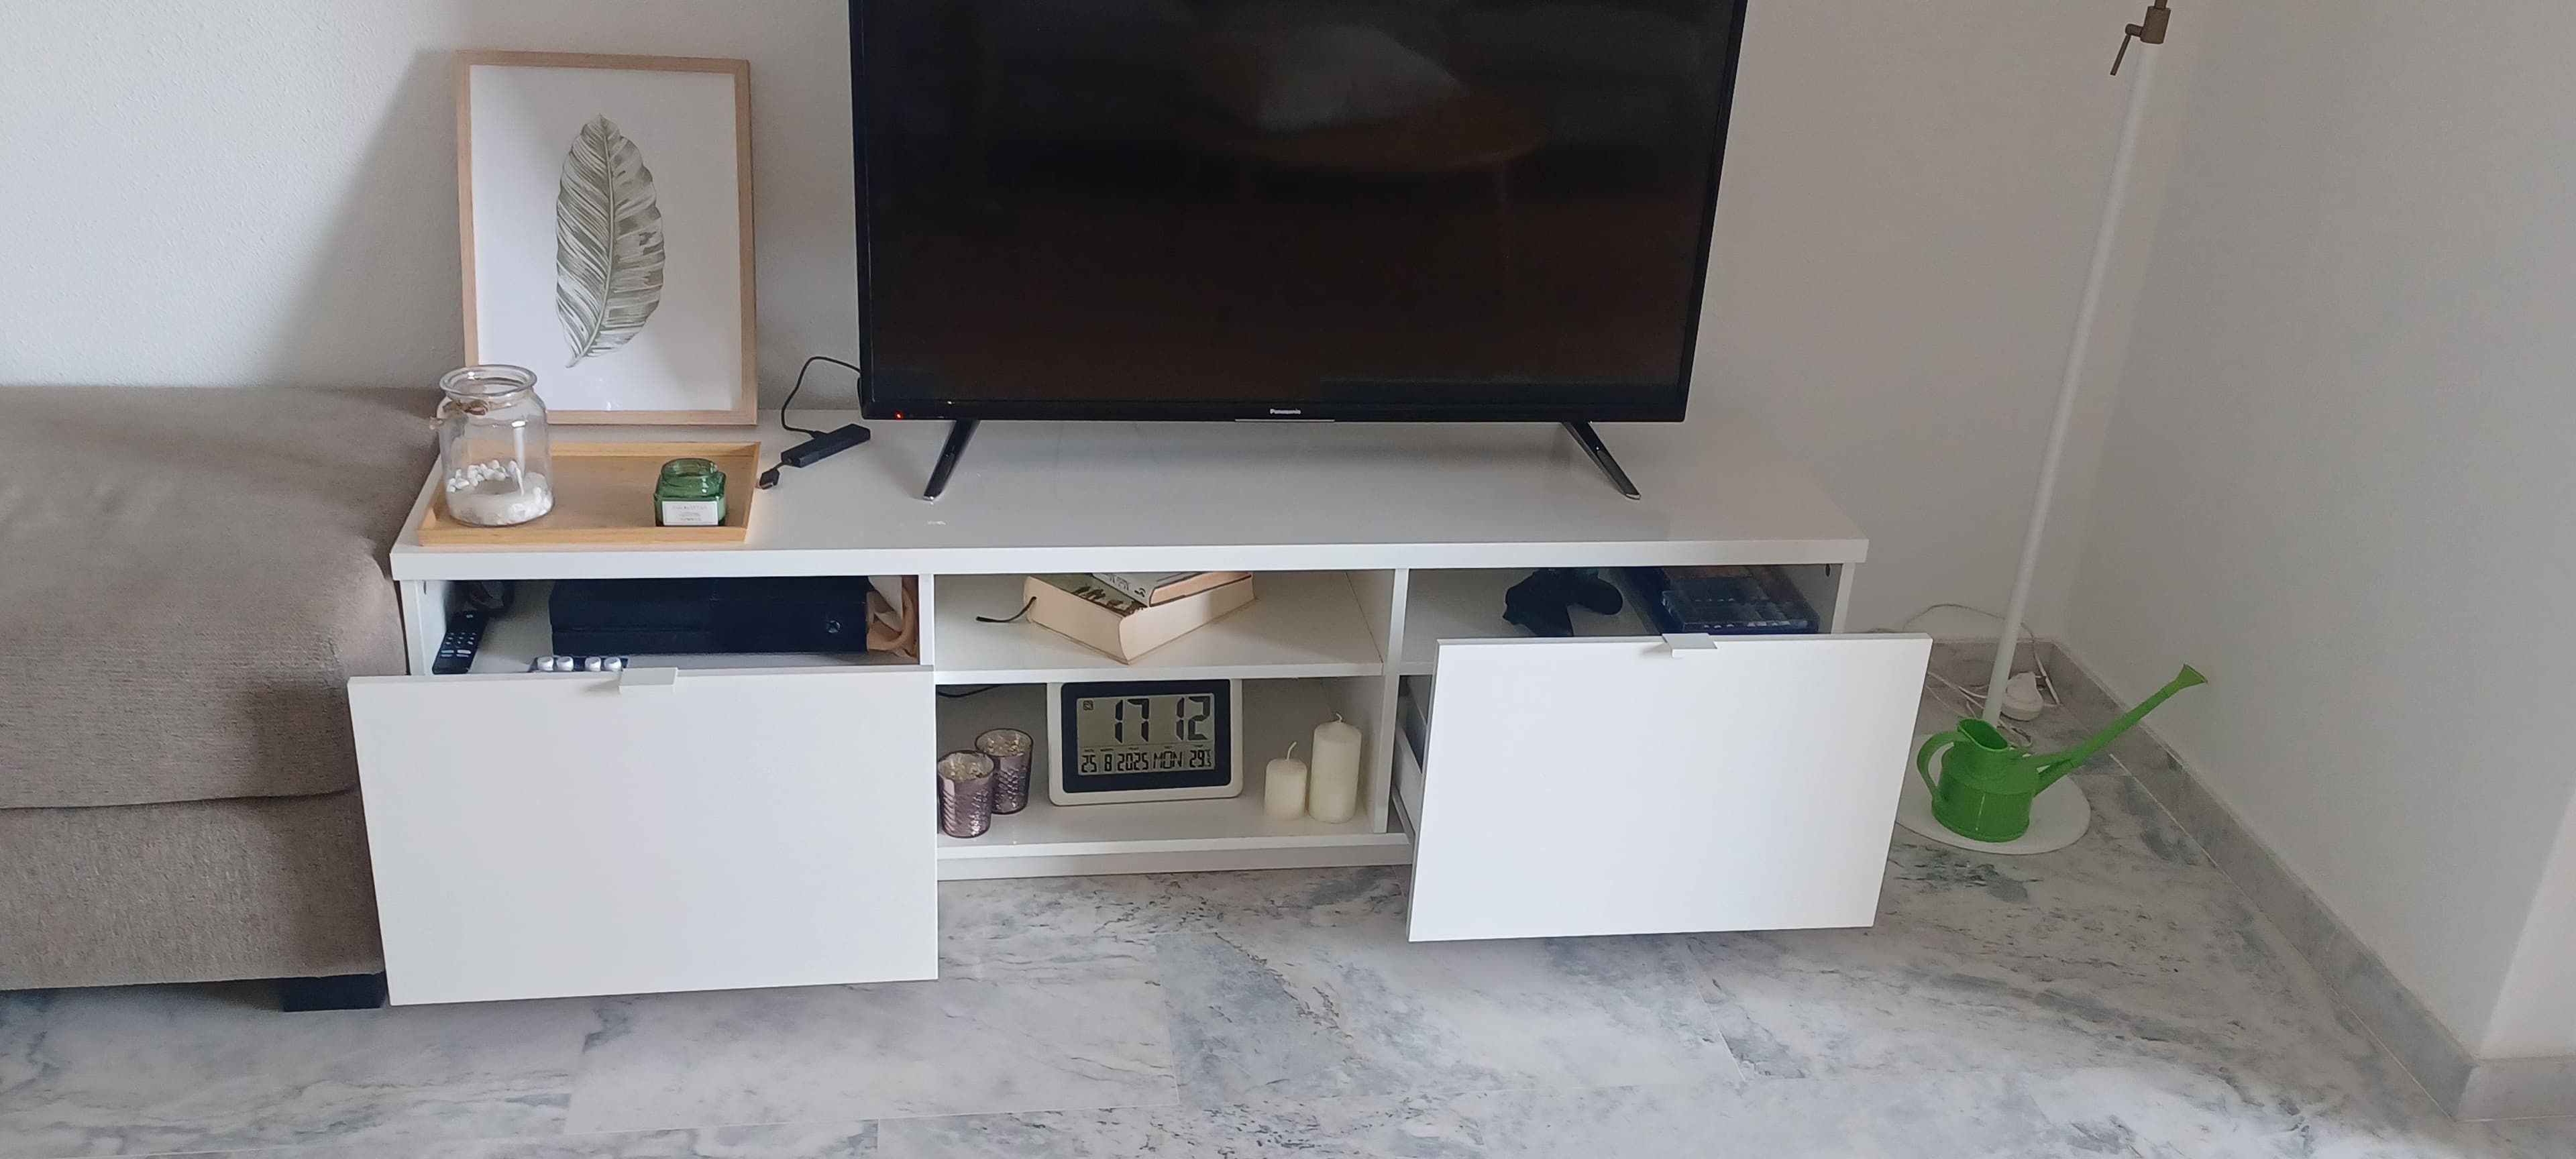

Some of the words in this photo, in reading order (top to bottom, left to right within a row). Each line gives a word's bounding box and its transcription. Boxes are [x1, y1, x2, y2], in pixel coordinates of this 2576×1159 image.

[1081, 755, 1097, 773] 25
[1104, 754, 1112, 771] 8
[1117, 752, 1149, 771] 2025
[1153, 751, 1182, 769] MON
